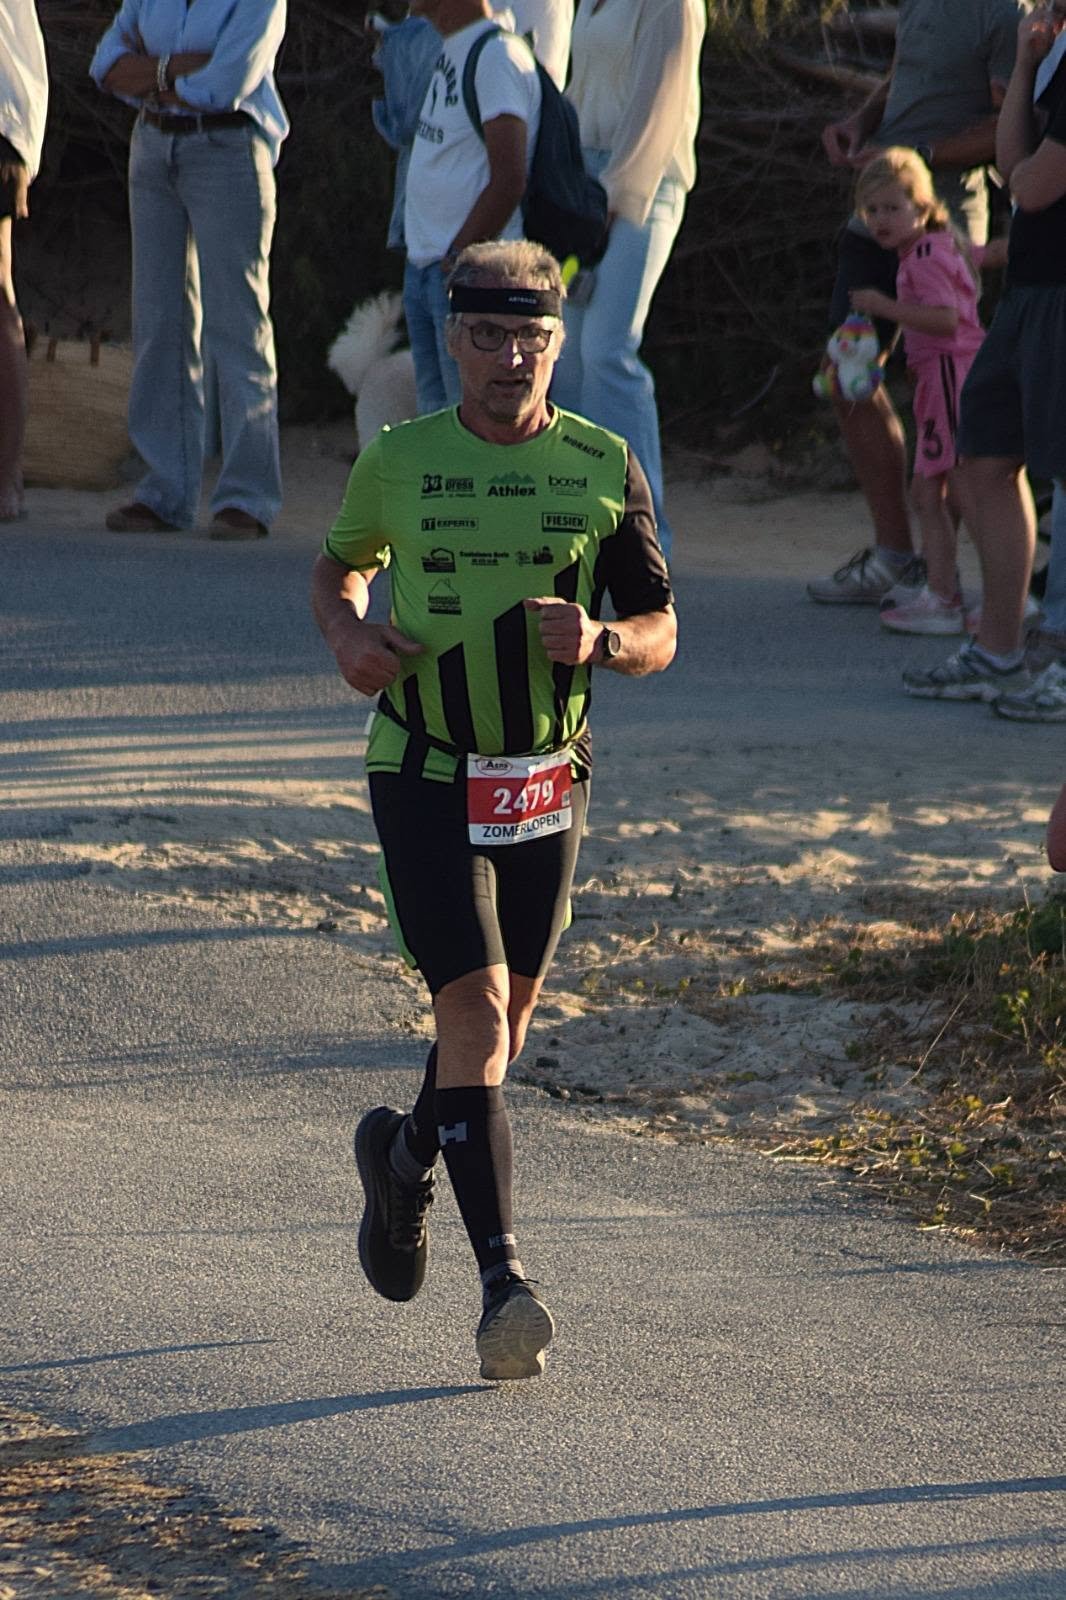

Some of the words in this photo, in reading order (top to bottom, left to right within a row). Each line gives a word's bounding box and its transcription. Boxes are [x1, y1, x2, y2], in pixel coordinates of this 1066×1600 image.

[562, 435, 606, 459] BIORACER
[487, 484, 536, 497] Athlex
[493, 779, 555, 815] 2479
[482, 813, 560, 838] ZOMERLOPEN
